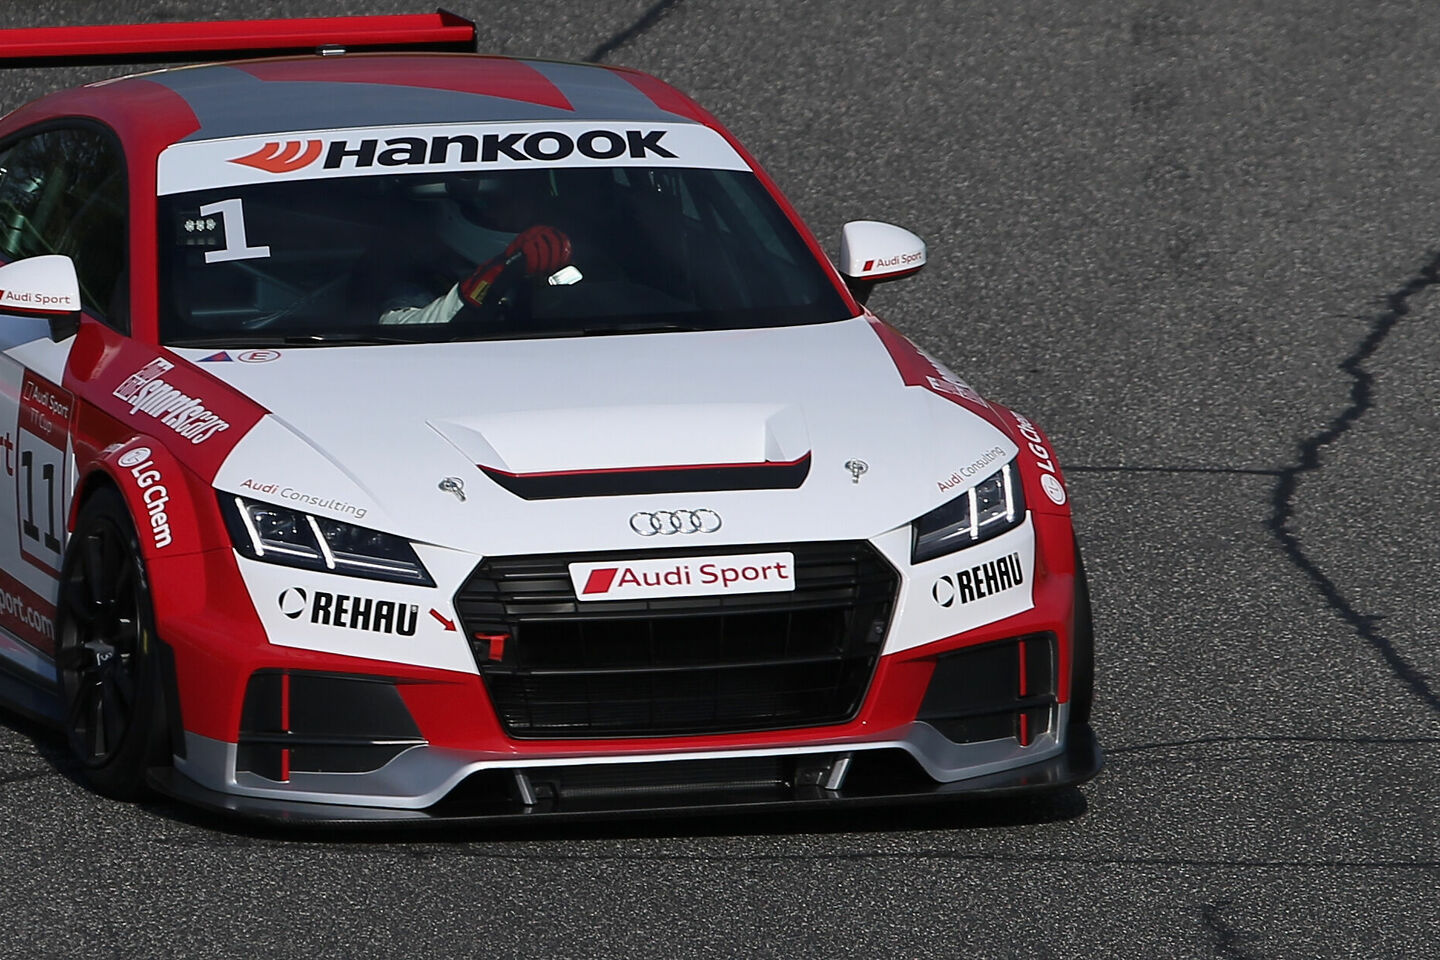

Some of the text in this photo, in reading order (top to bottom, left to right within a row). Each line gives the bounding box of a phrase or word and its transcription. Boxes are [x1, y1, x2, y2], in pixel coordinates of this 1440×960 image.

[199, 198, 271, 264] 1
[876, 251, 923, 268] Audi Sport
[6, 290, 72, 307] Audi Sport
[32, 385, 70, 420] Audi Sport
[936, 445, 1007, 493] Audi Consulting
[20, 450, 62, 556] 11
[142, 484, 173, 549] Chem
[240, 477, 368, 520] Audi Consulting
[617, 561, 790, 588] Audi Sport
[957, 551, 1024, 606] REHAU
[310, 590, 420, 637] REHAU
